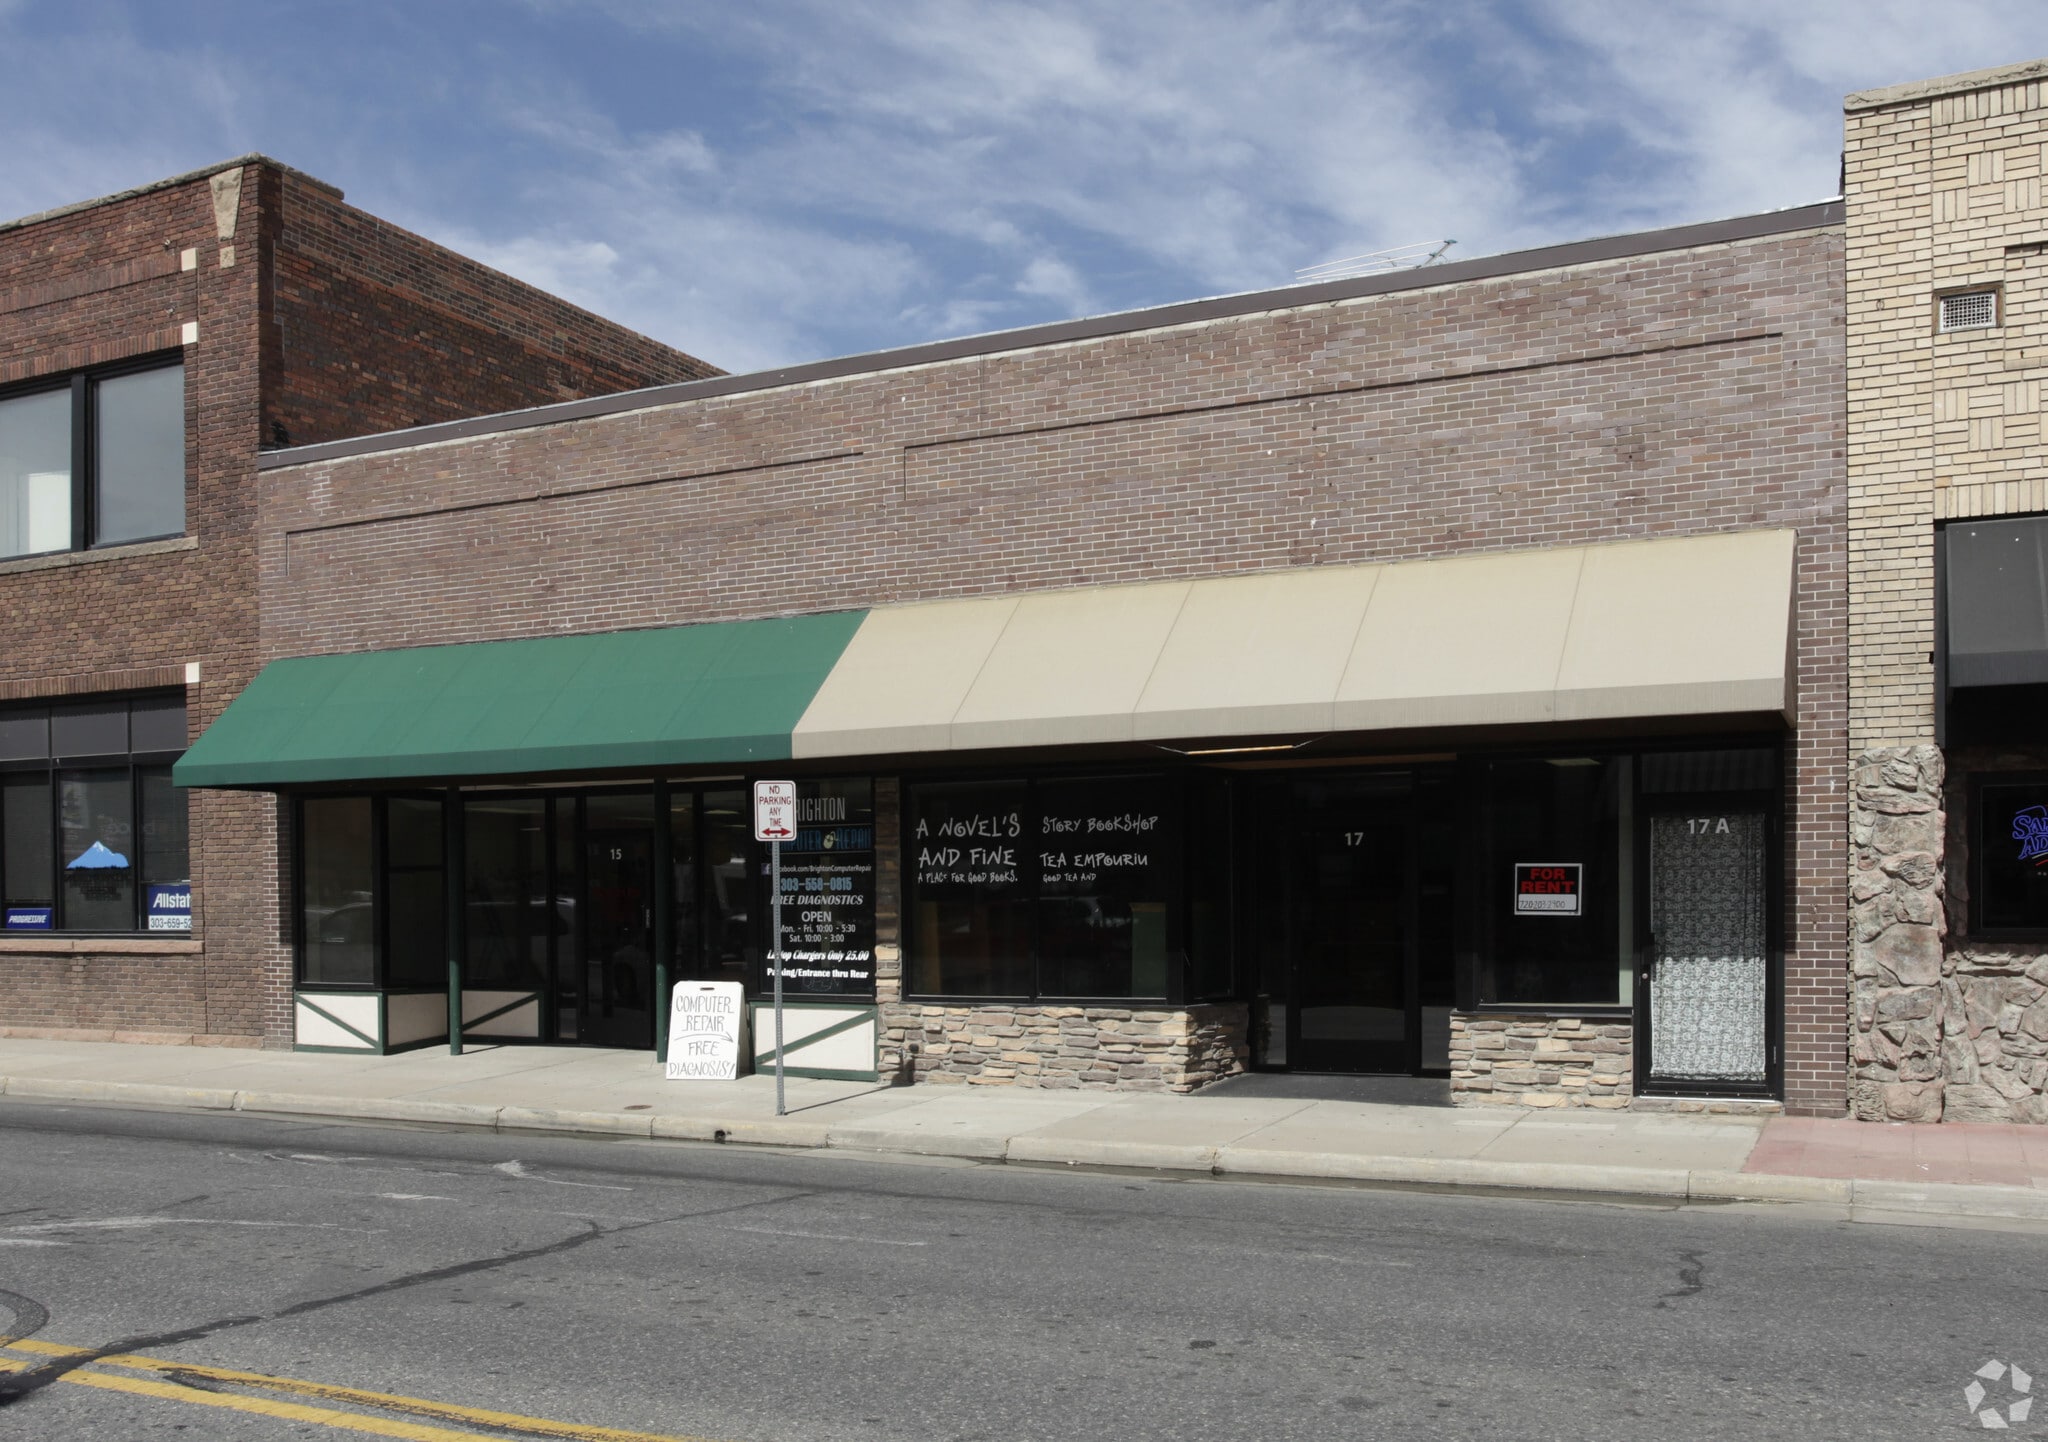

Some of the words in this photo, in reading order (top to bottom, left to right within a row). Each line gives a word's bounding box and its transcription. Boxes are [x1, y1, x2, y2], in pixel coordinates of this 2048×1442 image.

[769, 785, 781, 794] NO
[759, 796, 792, 805] PARKING
[769, 807, 781, 816] ANY
[796, 798, 846, 821] RIGHTON
[769, 817, 782, 827] TIME
[916, 818, 929, 839] A
[938, 813, 1021, 838] NOVEL'S
[1042, 815, 1082, 834] STORY
[1087, 813, 1159, 836] BOOKSHOP
[1345, 832, 1364, 846] 17
[610, 848, 622, 860] 15
[918, 847, 961, 869] AND
[1039, 852, 1067, 868] TEA
[951, 872, 965, 882] FOR
[968, 872, 987, 884] GOOD
[1042, 873, 1062, 884] GOOD
[1064, 873, 1078, 882] TEA
[1080, 872, 1097, 882] AND
[1530, 868, 1566, 880] FOR
[1521, 881, 1575, 893] RENT
[153, 893, 191, 908] Allstat
[797, 894, 864, 905] DIAGNOSTICS
[801, 911, 832, 922] OPEN
[150, 917, 191, 929] 303-659-52
[781, 924, 795, 933] Mon.
[803, 924, 813, 933] Fri.
[816, 924, 833, 933] 10:00
[841, 924, 856, 933] 5:30
[789, 934, 802, 943] Sat.
[804, 934, 821, 943] 10:00
[830, 934, 845, 943] 3:00
[767, 949, 792, 961] Latop
[793, 949, 826, 962] Chargers
[827, 950, 845, 962] Only
[845, 950, 870, 961] 25.00
[766, 967, 831, 978] Paing/Entrance
[832, 968, 848, 978] thru
[850, 969, 869, 979] Rear
[676, 995, 735, 1014] COMPUTER
[681, 1015, 725, 1032] REPAIR
[687, 1040, 720, 1056] FREE
